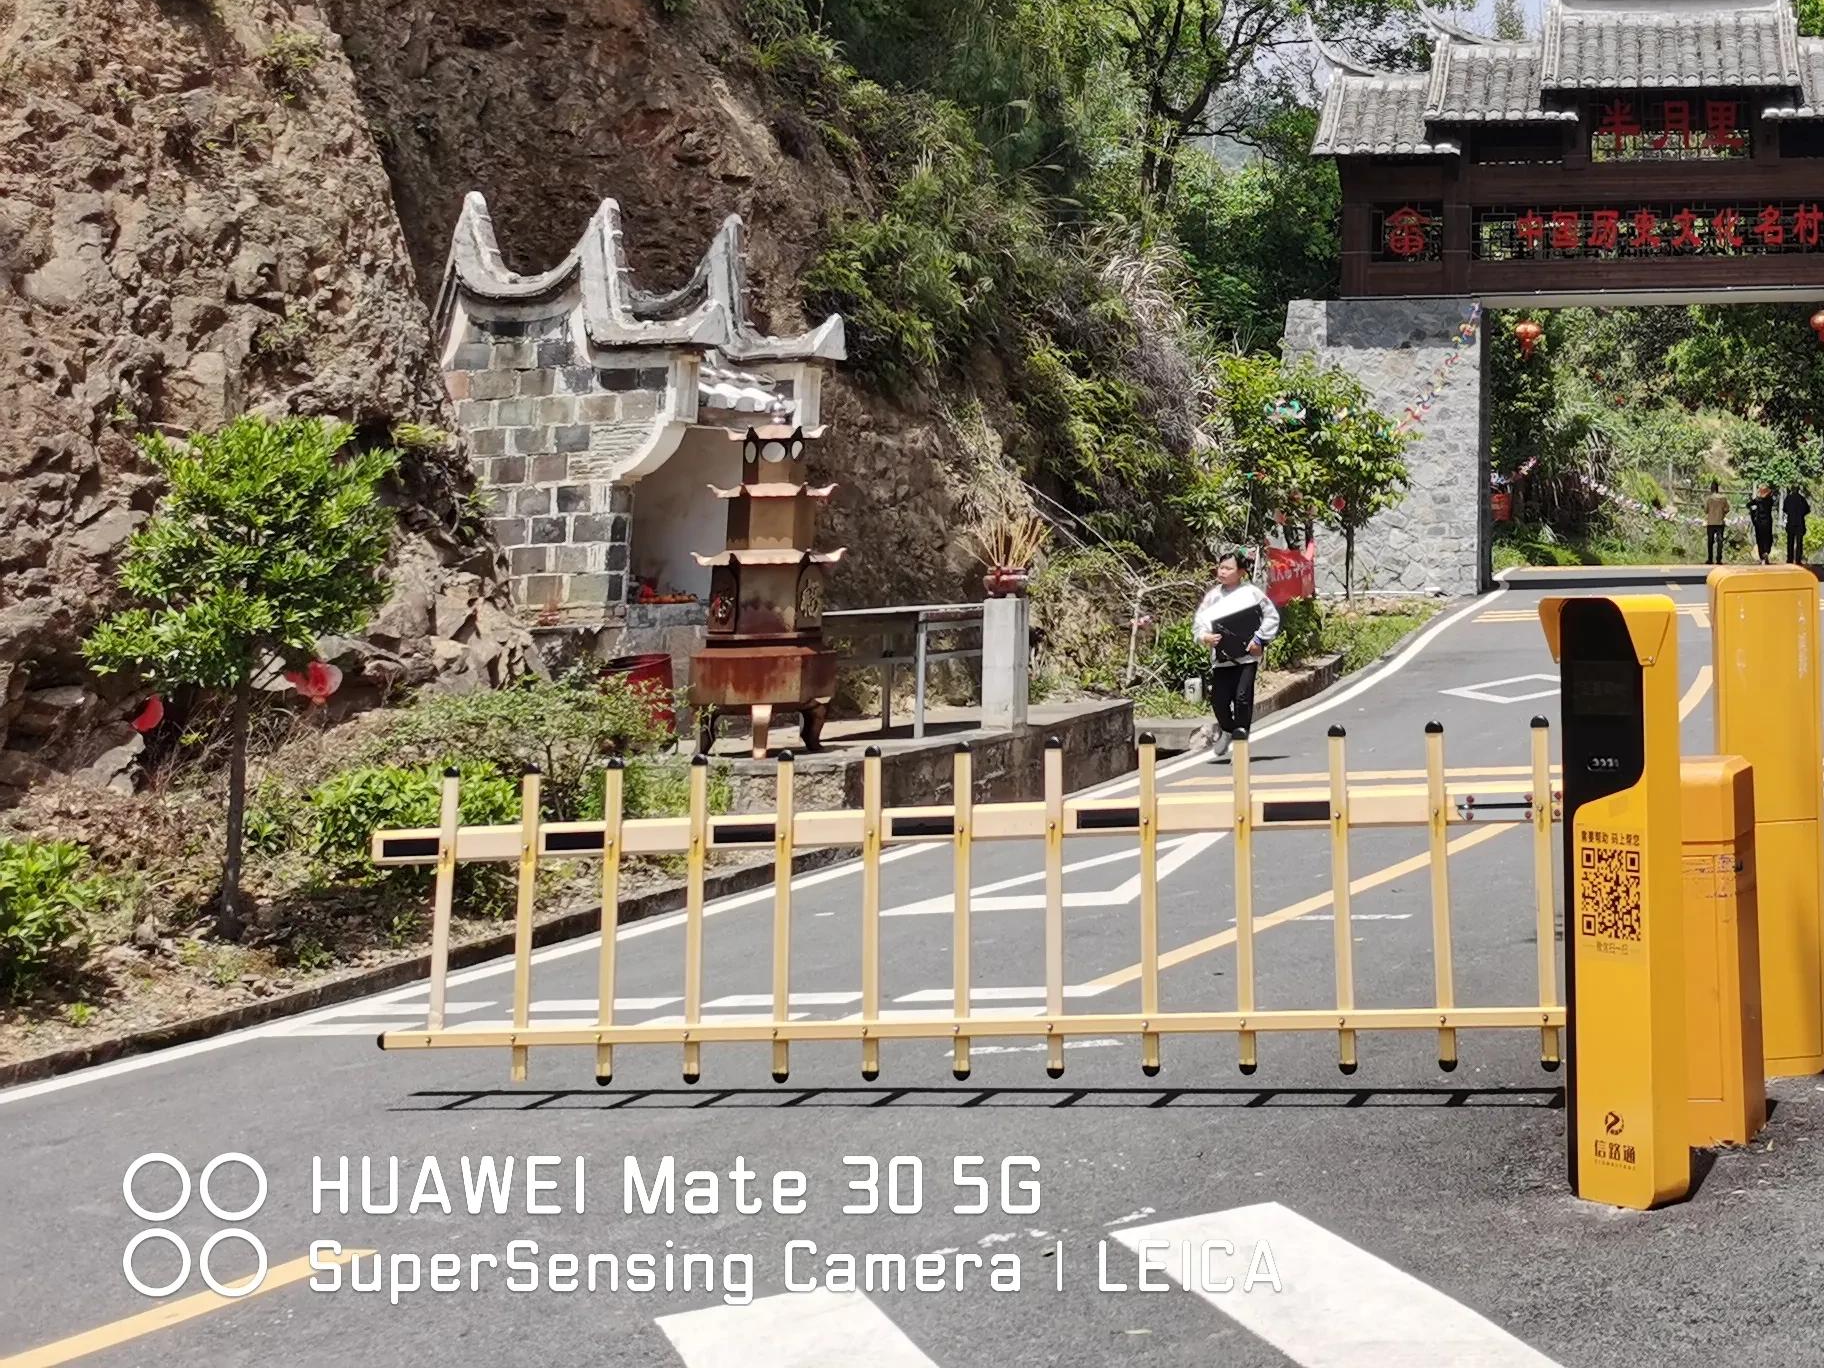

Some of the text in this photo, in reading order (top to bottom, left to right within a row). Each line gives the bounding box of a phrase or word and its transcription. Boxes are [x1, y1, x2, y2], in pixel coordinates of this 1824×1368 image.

[1599, 97, 1747, 151] 半月里
[1517, 205, 1824, 250] 中国历史文化名村
[1594, 1139, 1636, 1164] 信路通
